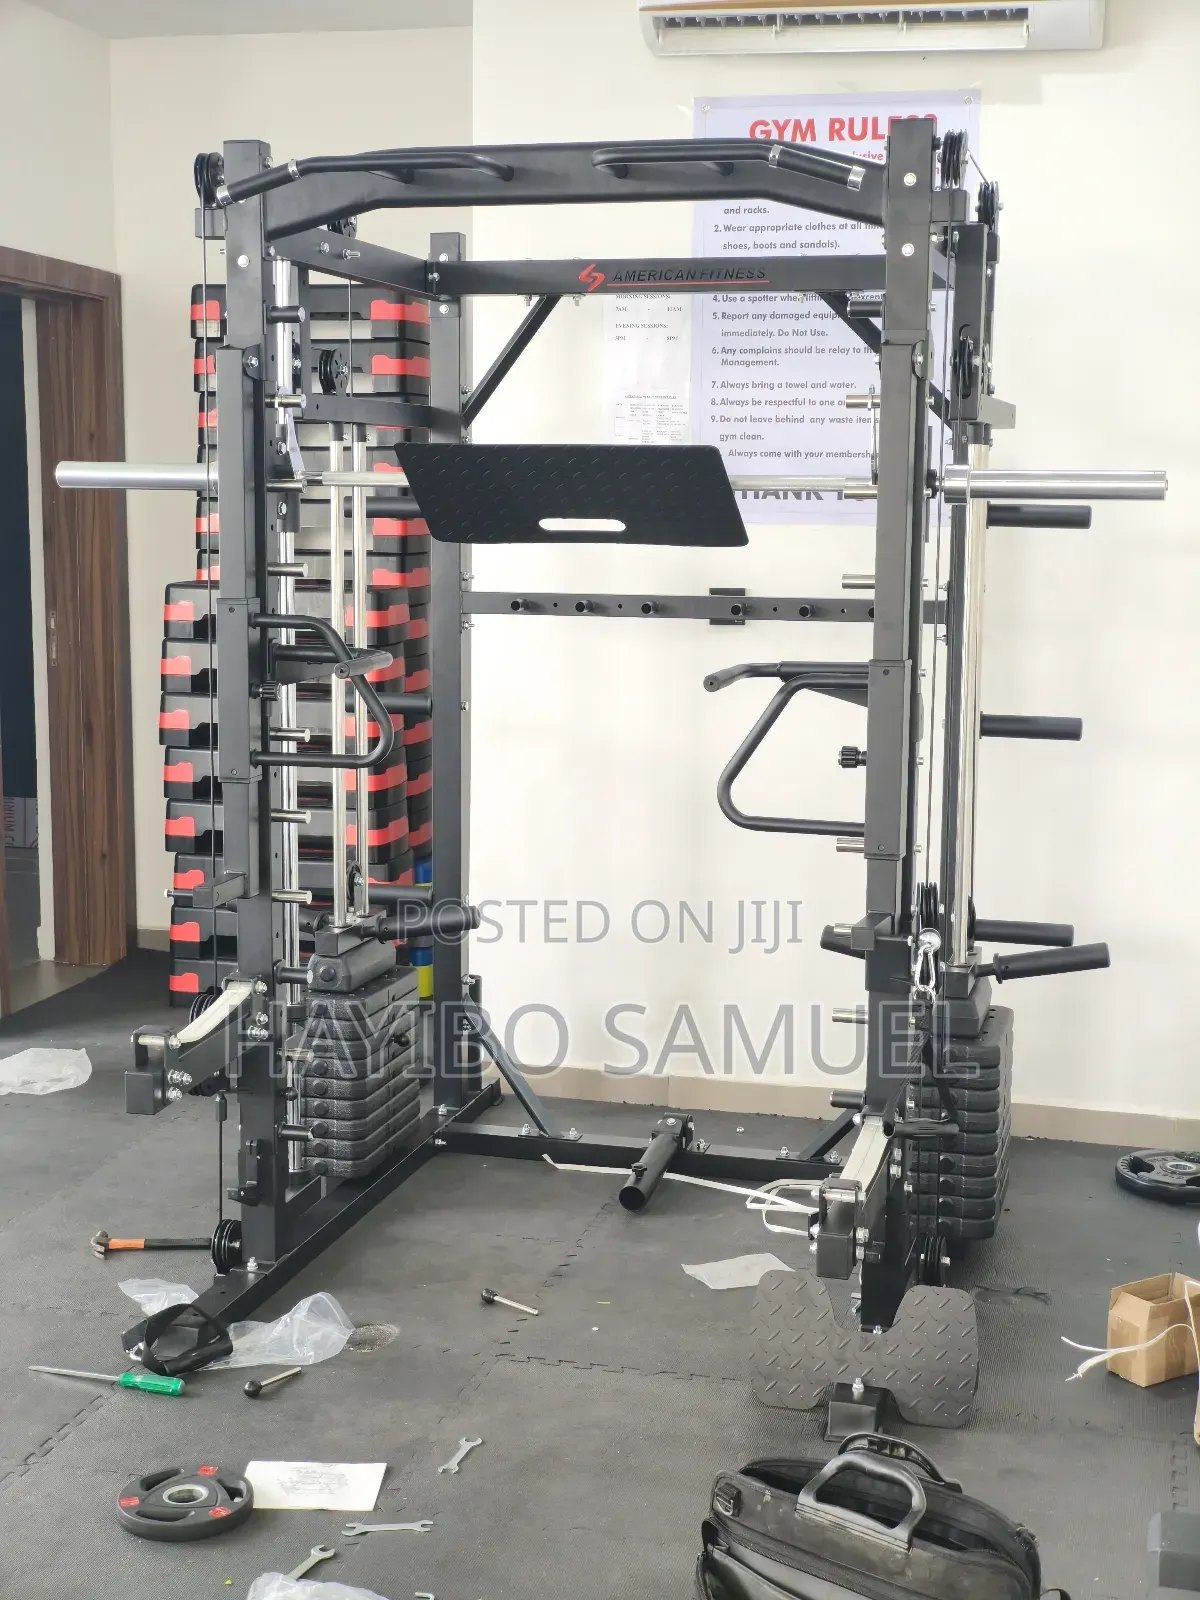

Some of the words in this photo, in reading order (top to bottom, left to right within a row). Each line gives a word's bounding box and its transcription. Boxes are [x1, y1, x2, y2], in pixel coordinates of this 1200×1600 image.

[749, 118, 817, 142] GYM
[723, 206, 741, 215] and
[743, 205, 770, 215] racks.
[713, 224, 722, 233] 2.
[723, 224, 747, 233] Wear
[749, 222, 803, 234] appropriate
[805, 222, 836, 231] clothes
[838, 222, 848, 231] at
[850, 222, 862, 231] all
[722, 241, 751, 251] shoes,
[753, 240, 777, 250] boots
[779, 239, 797, 249] and
[799, 239, 840, 250] sandals).
[613, 267, 696, 282] AMERICAN
[699, 267, 766, 280] FITNESS
[722, 294, 737, 302] Use
[747, 293, 778, 304] spotter
[712, 312, 720, 320] 5.
[721, 311, 749, 322] Report
[751, 313, 768, 323] any
[769, 311, 811, 323] damaged
[721, 328, 775, 338] immediately.
[777, 328, 790, 337] Do
[792, 328, 807, 337] Not
[809, 328, 829, 337] Use.
[711, 347, 719, 355] 6.
[720, 346, 738, 357] Any
[739, 346, 782, 357] complains
[784, 345, 812, 355] should
[815, 345, 826, 354] be
[828, 345, 851, 356] relay
[852, 346, 861, 354] to
[720, 357, 780, 368] Management.
[711, 381, 719, 389] 7.
[720, 380, 750, 390] Always
[752, 380, 775, 391] bring
[785, 380, 808, 389] towel
[810, 380, 828, 389] and
[829, 381, 857, 389] water.
[710, 398, 719, 406] 8.
[719, 398, 750, 408] Always
[751, 397, 763, 406] be
[764, 397, 806, 409] respectful
[808, 398, 817, 406] to
[710, 415, 719, 423] 9.
[719, 415, 731, 424] Do
[733, 415, 748, 424] not
[749, 415, 773, 424] leave
[775, 414, 805, 424] behind
[809, 416, 826, 425] any
[828, 415, 853, 424] waste
[719, 433, 737, 442] gym
[739, 431, 765, 441] clean.
[728, 448, 758, 459] Always
[759, 450, 782, 459] come
[784, 449, 802, 459] with
[804, 451, 823, 460] your
[825, 449, 880, 460] membersh
